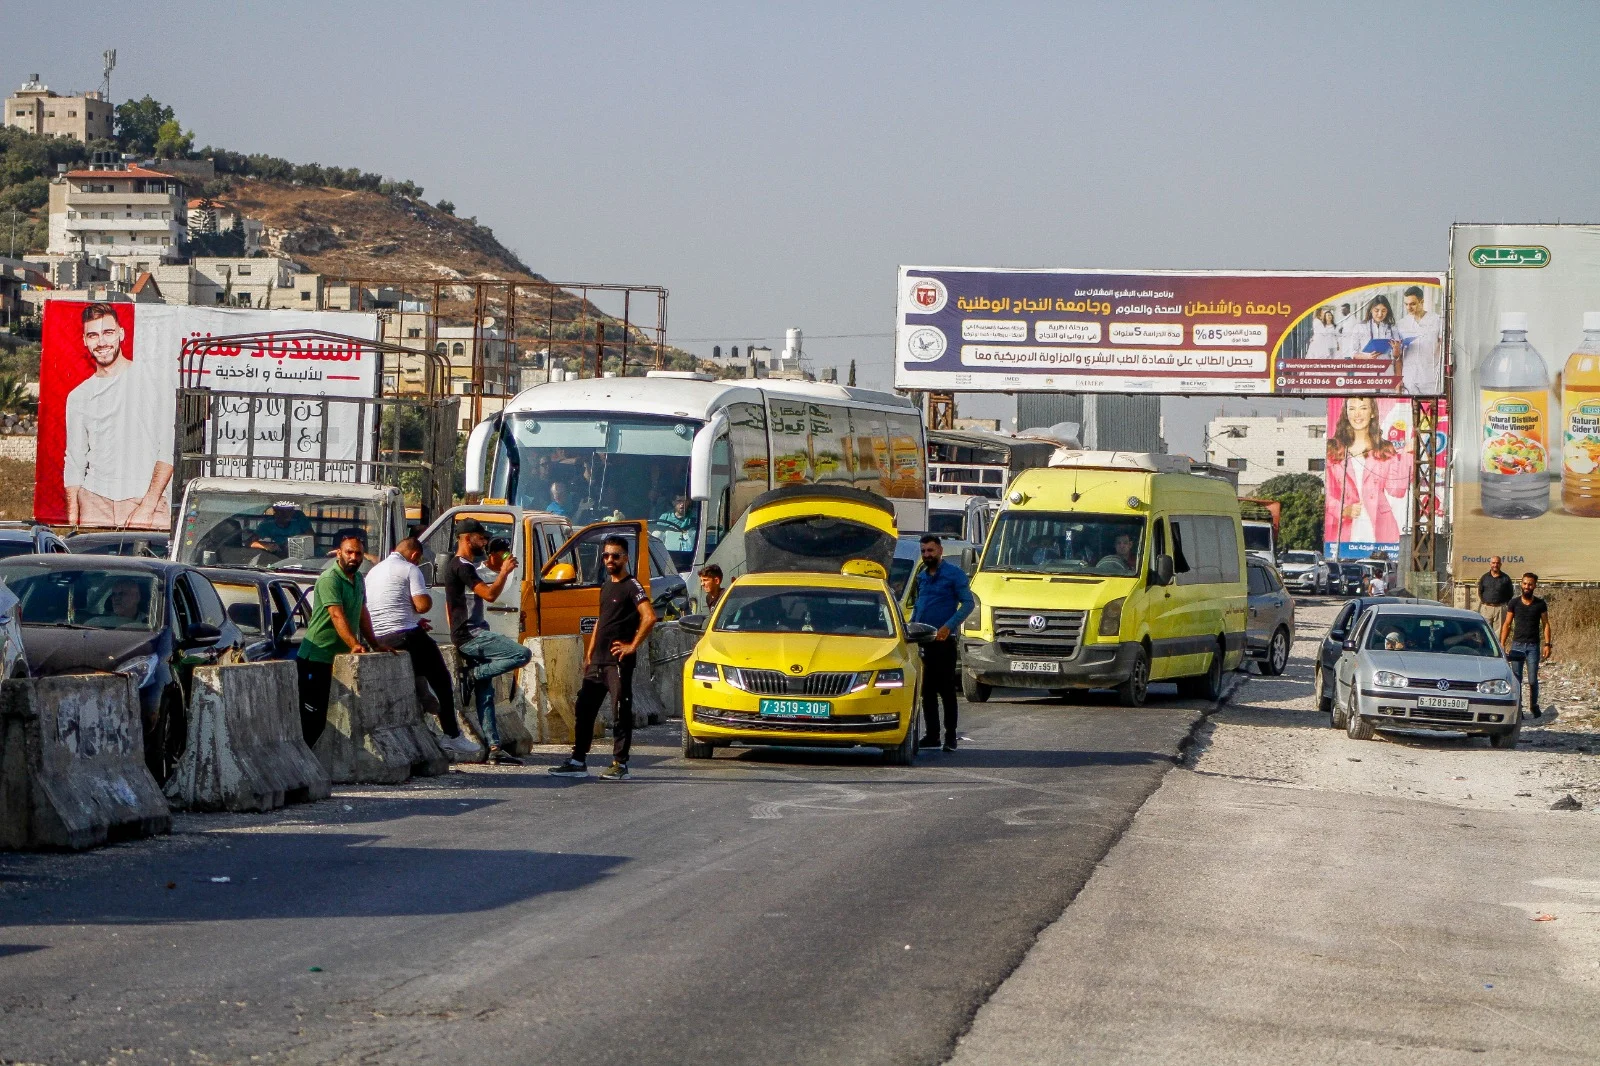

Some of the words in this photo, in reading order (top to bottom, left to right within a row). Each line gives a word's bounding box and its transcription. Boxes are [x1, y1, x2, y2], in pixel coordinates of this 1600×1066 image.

[1478, 249, 1542, 265] فرشلي
[1074, 289, 1086, 297] بين
[1087, 288, 1113, 297] المشترك
[1114, 290, 1136, 299] البشري
[1136, 289, 1153, 300] الطب
[1153, 290, 1174, 300] برنامج
[957, 296, 1010, 313] الوطنية
[1012, 297, 1052, 313] النجاح
[1055, 298, 1111, 315] وجامعة
[1115, 304, 1152, 316] والعلوم
[1154, 304, 1182, 315] للصحة
[1184, 299, 1242, 317] واشنطن
[1245, 301, 1291, 317] جامعة
[1112, 329, 1134, 337] سنوات
[1134, 326, 1142, 337] 5
[1167, 330, 1181, 338] مدة
[251, 333, 362, 365] السندباد
[993, 351, 1037, 364] الامريكية
[1039, 352, 1082, 365] والمزاولة
[1084, 352, 1115, 366] البشري
[1116, 353, 1140, 366] الطب
[1141, 353, 1175, 366] شهادة
[1176, 355, 1193, 367] على
[1195, 355, 1225, 367] الطالب
[1226, 355, 1254, 368] يحصل
[215, 363, 259, 380] الأحذية
[263, 370, 271, 383] و
[274, 366, 323, 383] للألبسة
[1488, 415, 1511, 424] Natural
[1512, 415, 1539, 424] Distilled
[1572, 416, 1600, 426] Natural
[1491, 423, 1509, 431] White
[1510, 423, 1536, 432] Vinegar
[1572, 425, 1592, 434] Cider
[1462, 555, 1491, 563] Produc
[1507, 555, 1525, 563] USA
